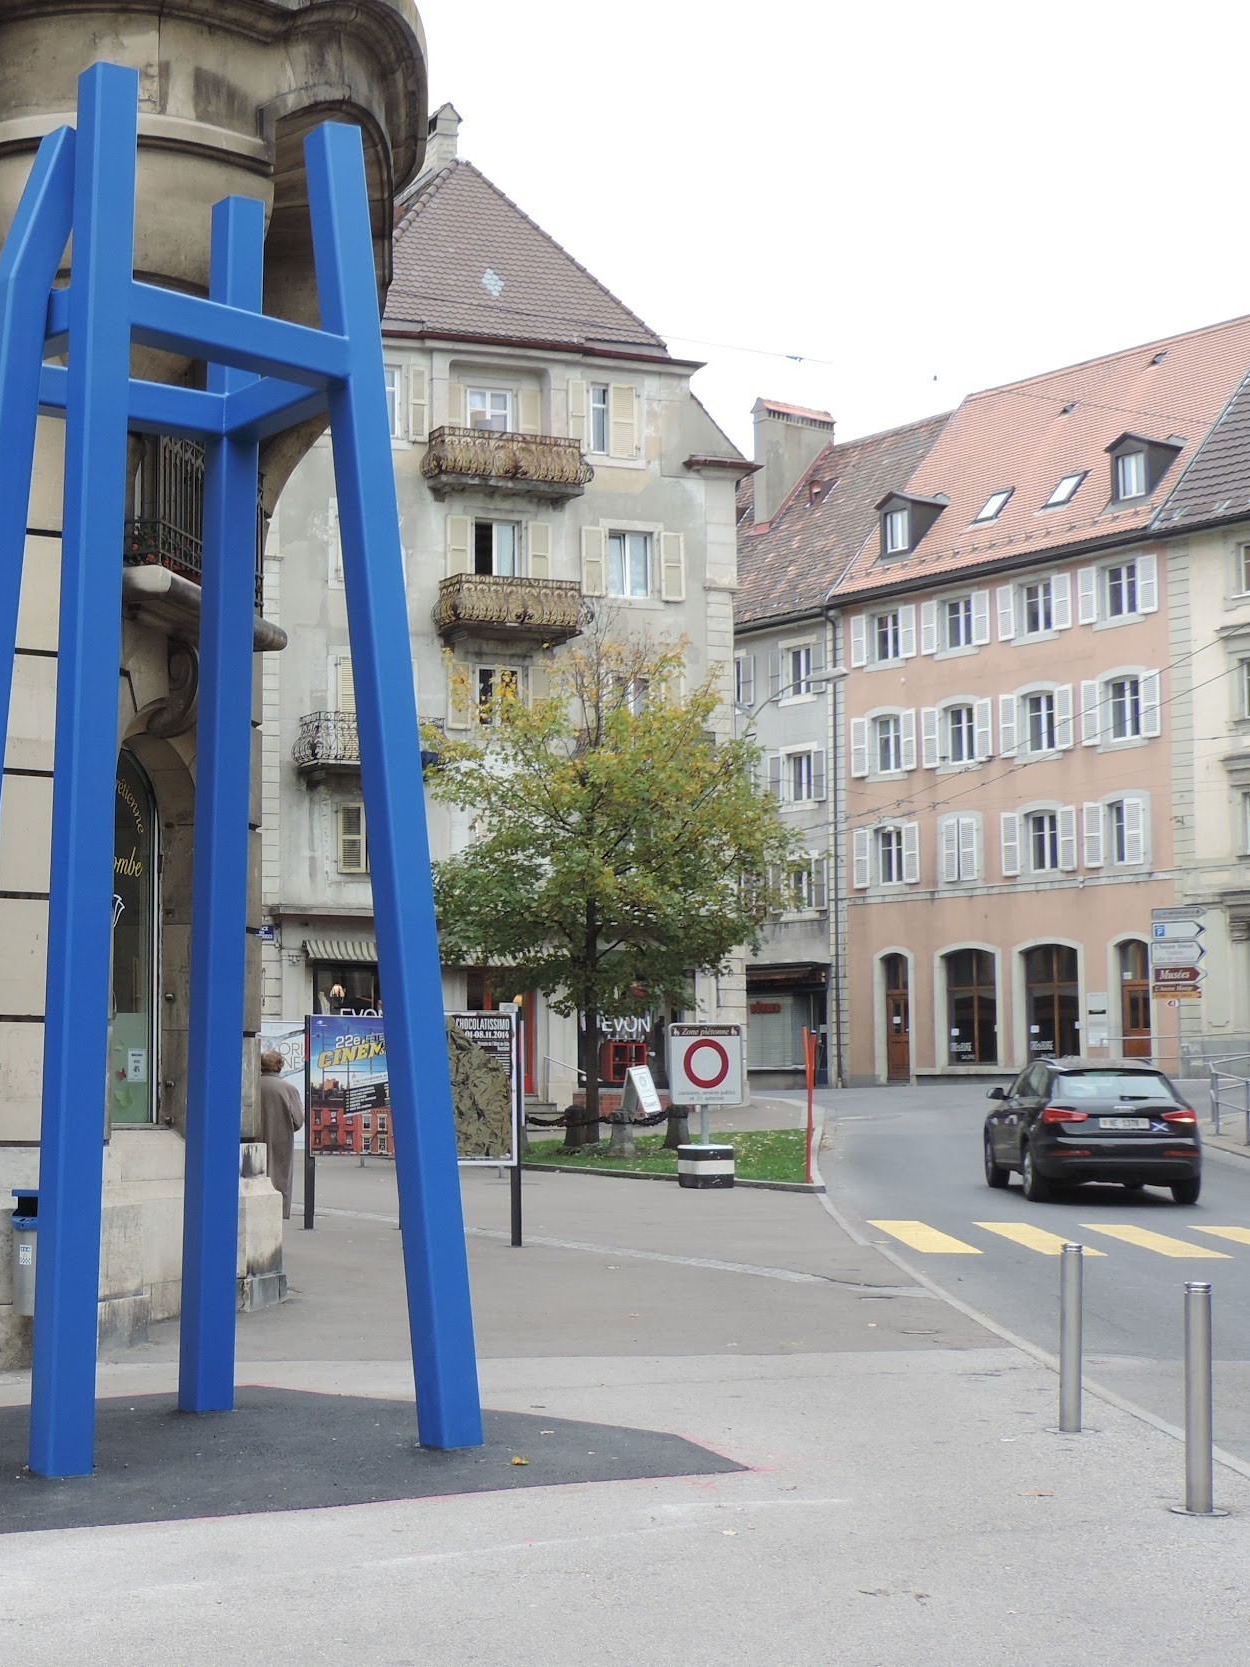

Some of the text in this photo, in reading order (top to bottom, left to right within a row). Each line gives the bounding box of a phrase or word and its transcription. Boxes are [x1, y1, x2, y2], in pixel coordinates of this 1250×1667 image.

[113, 846, 143, 877] ombe
[1159, 969, 1191, 980] Musées
[455, 1018, 510, 1031] CHOCOLATISSIMO
[464, 1030, 510, 1039] 01-08.11.2014
[681, 1027, 700, 1036] Zone
[317, 1039, 386, 1070] CINÉM
